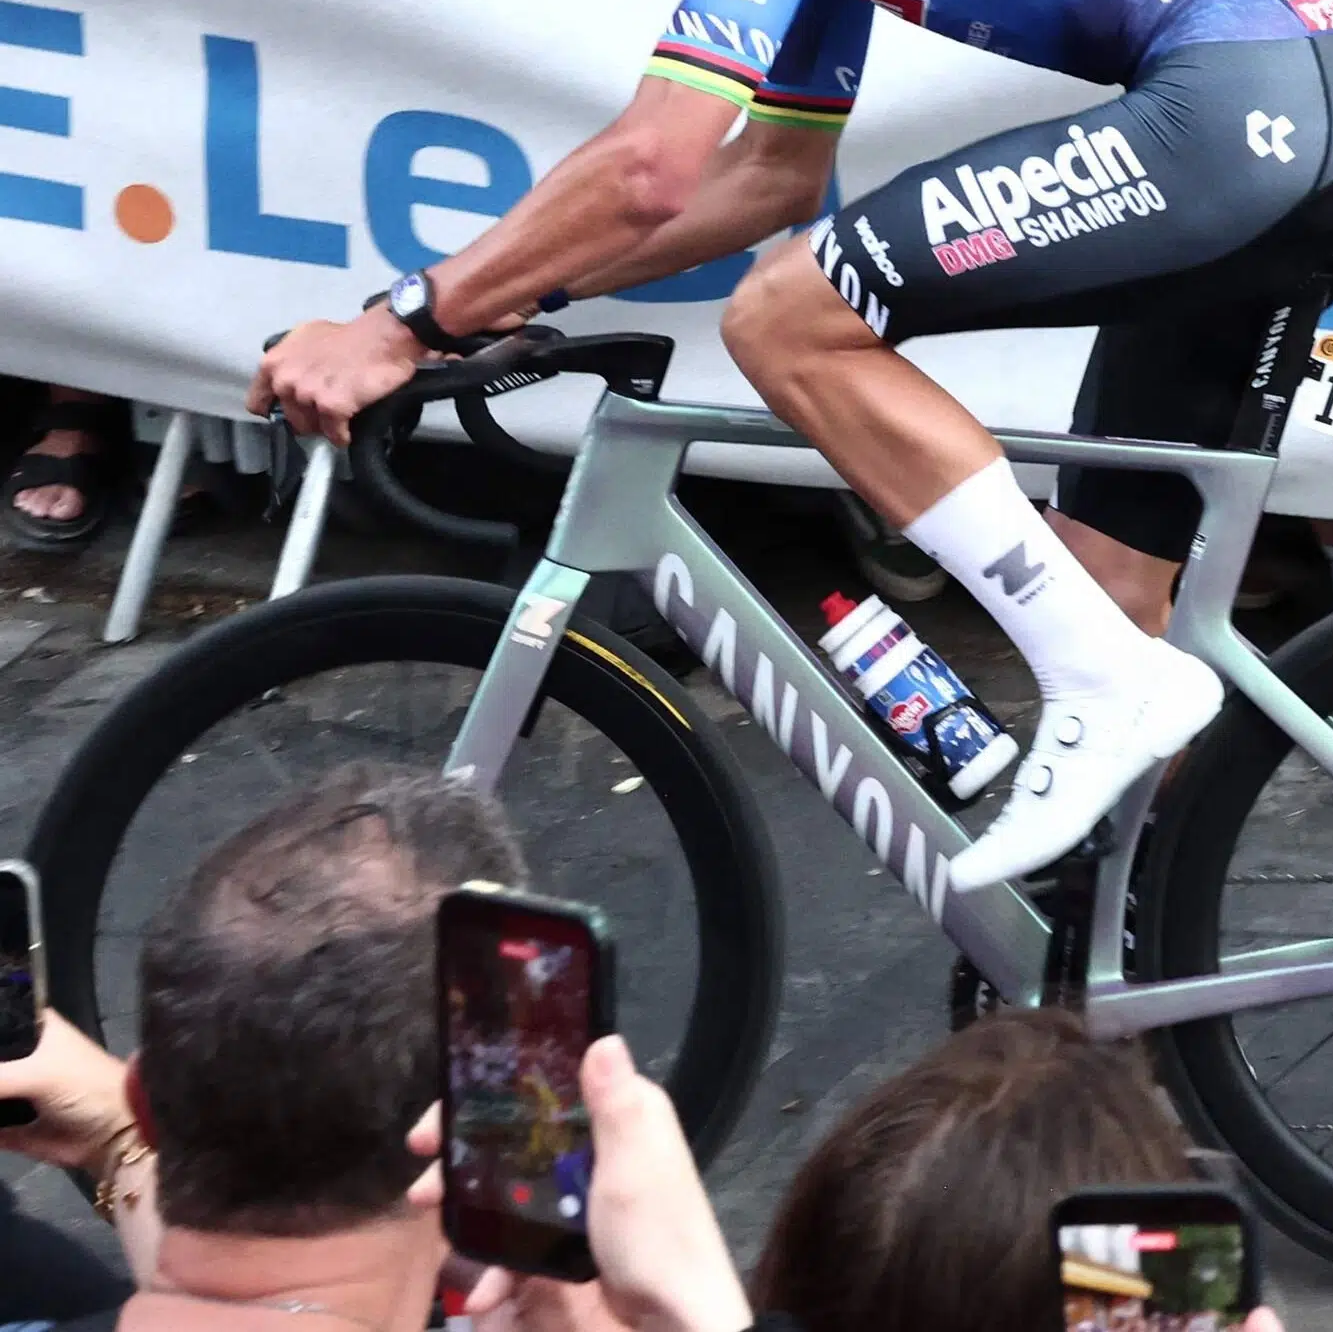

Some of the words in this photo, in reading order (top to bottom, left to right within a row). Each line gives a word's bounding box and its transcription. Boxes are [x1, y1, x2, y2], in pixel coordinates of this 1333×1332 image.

[921, 124, 1148, 246] Alpecin
[1019, 180, 1168, 248] SHAMPOO
[854, 215, 904, 288] wahoo
[931, 226, 1018, 277] DMG
[653, 553, 951, 925] CANYON
